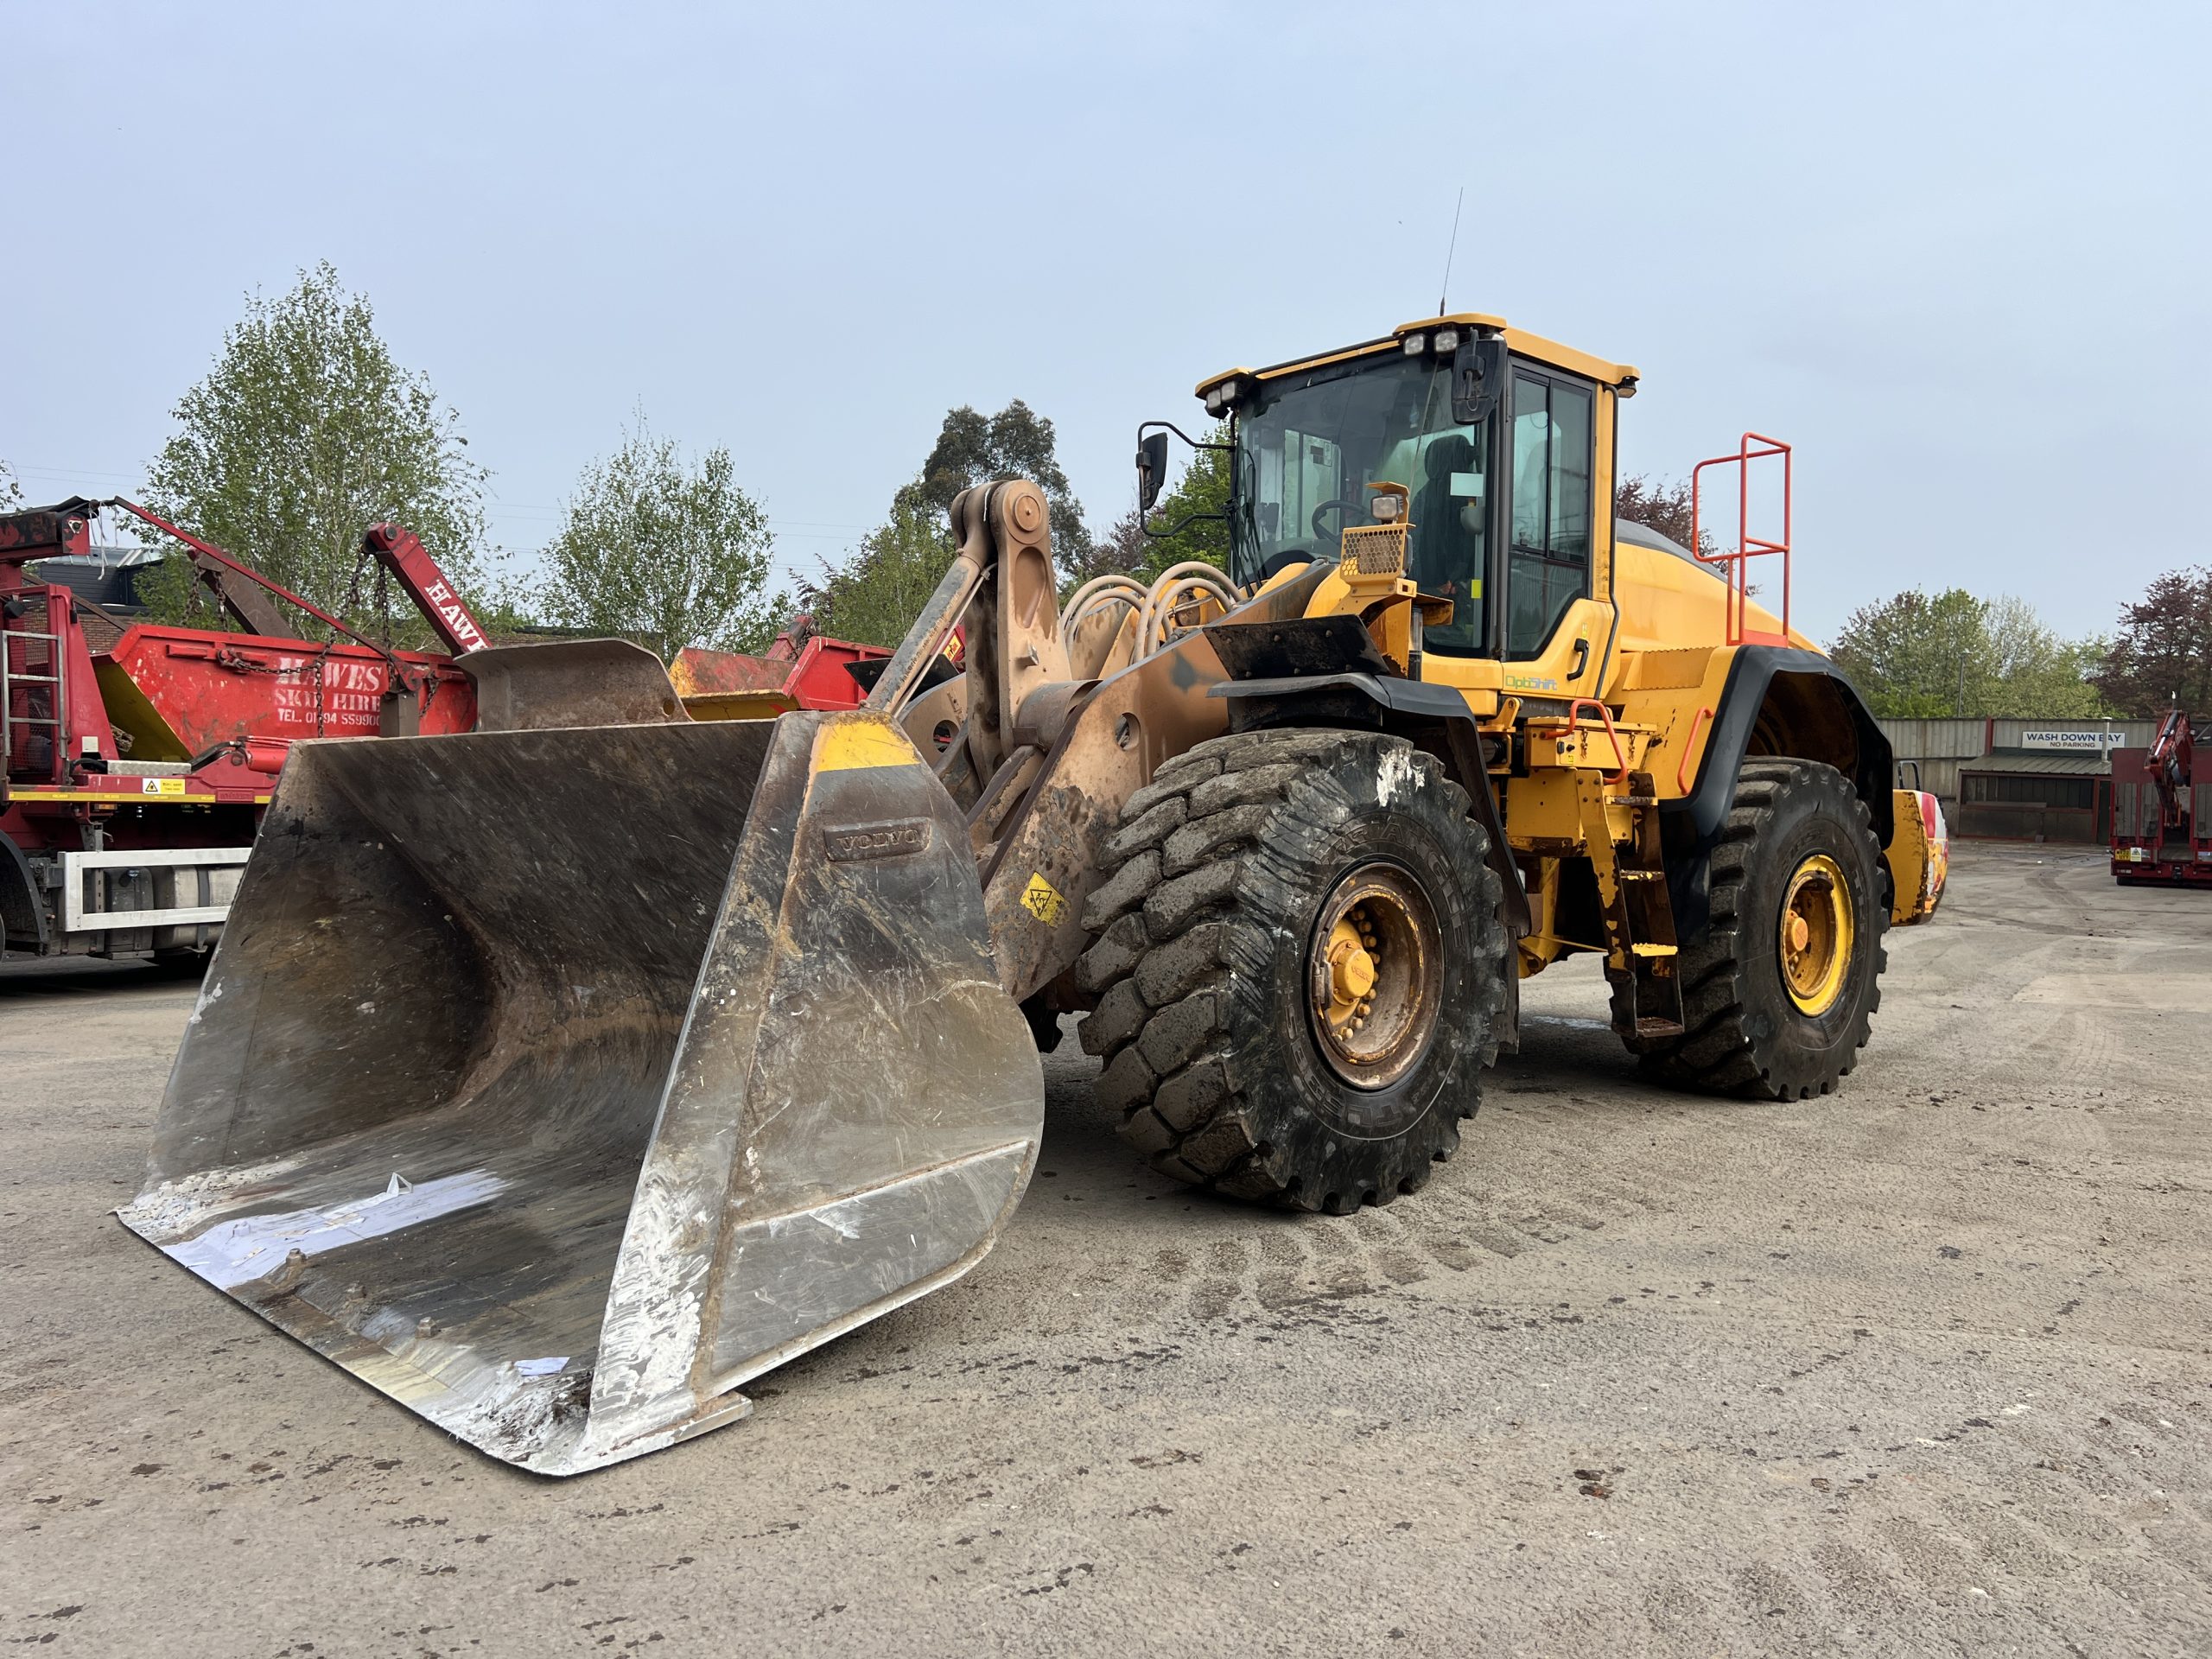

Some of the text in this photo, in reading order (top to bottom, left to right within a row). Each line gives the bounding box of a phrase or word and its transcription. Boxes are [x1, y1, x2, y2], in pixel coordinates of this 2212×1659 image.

[276, 657, 382, 692] HAWES
[275, 689, 380, 712] SKIP HIRE
[277, 708, 302, 723] TEL.
[305, 712, 337, 725] 0194
[2026, 733, 2058, 741] WASH
[2061, 734, 2095, 742] DOWN
[836, 829, 918, 852] VOLVO
